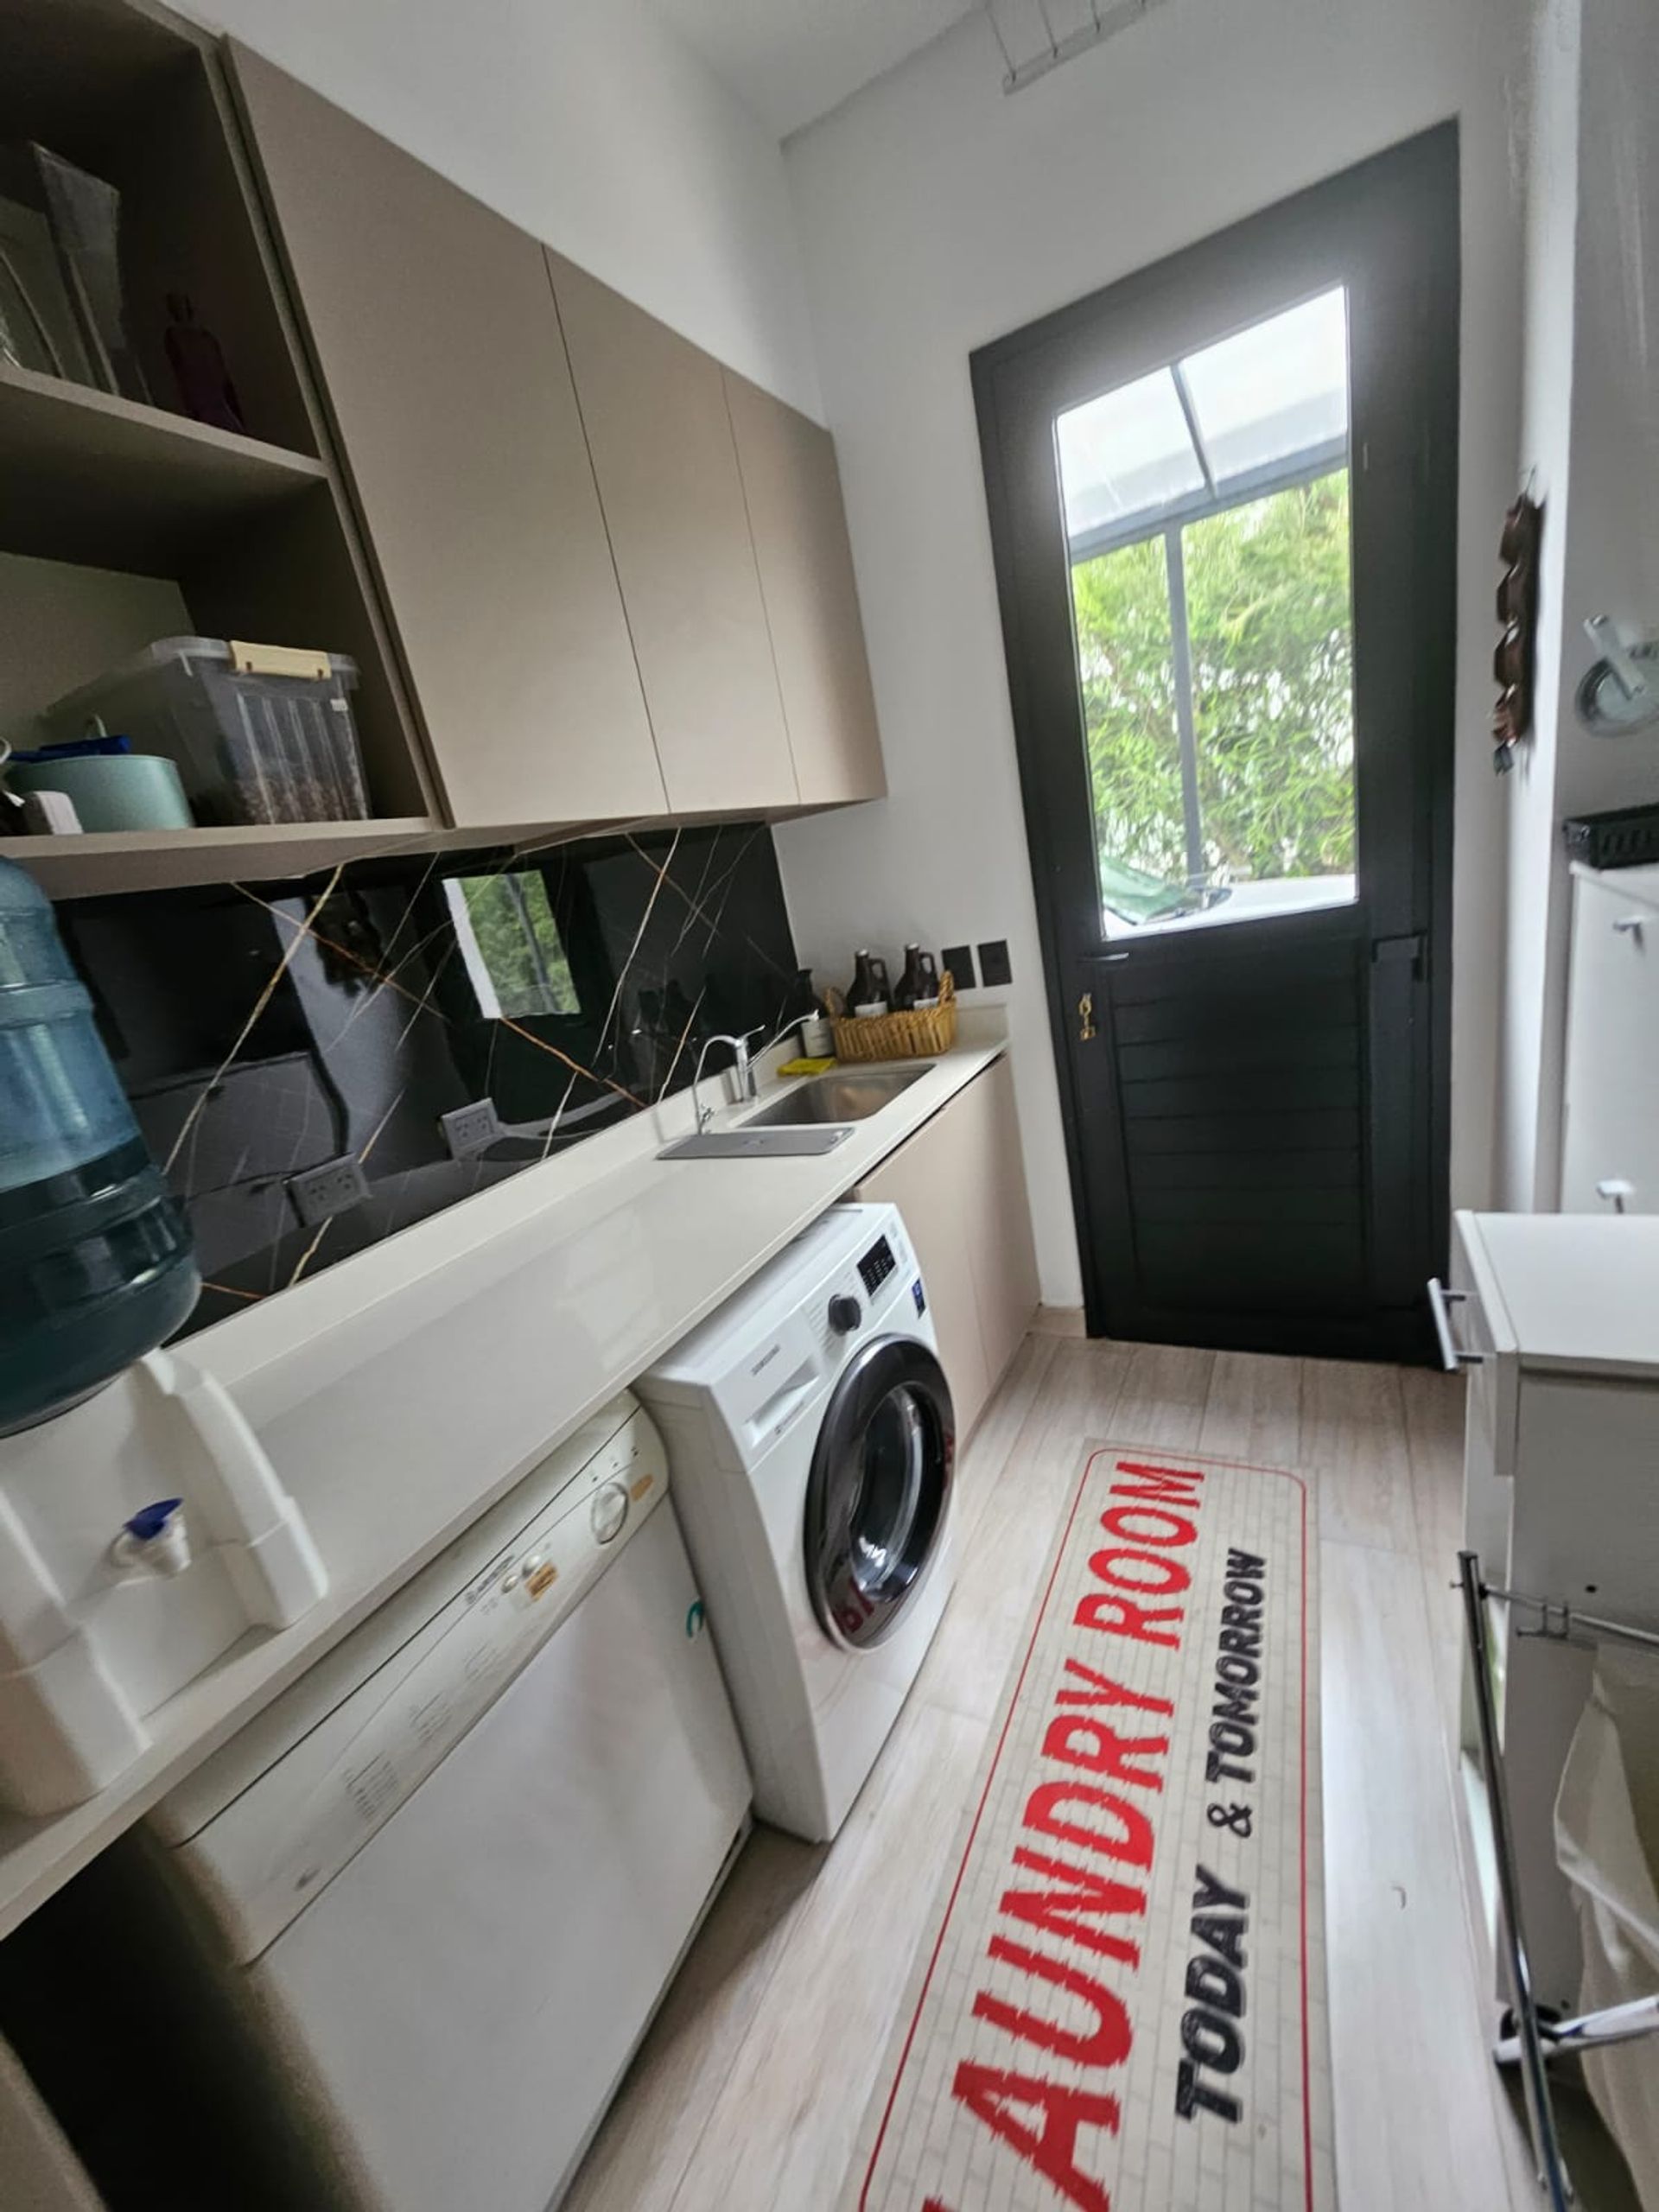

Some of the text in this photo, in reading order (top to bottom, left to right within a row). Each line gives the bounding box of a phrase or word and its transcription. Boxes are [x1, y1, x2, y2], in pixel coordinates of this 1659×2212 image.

[921, 1460, 1205, 2212] AUNDRY ROOM
[1175, 1547, 1267, 2124] TODAY & TOMORROW
